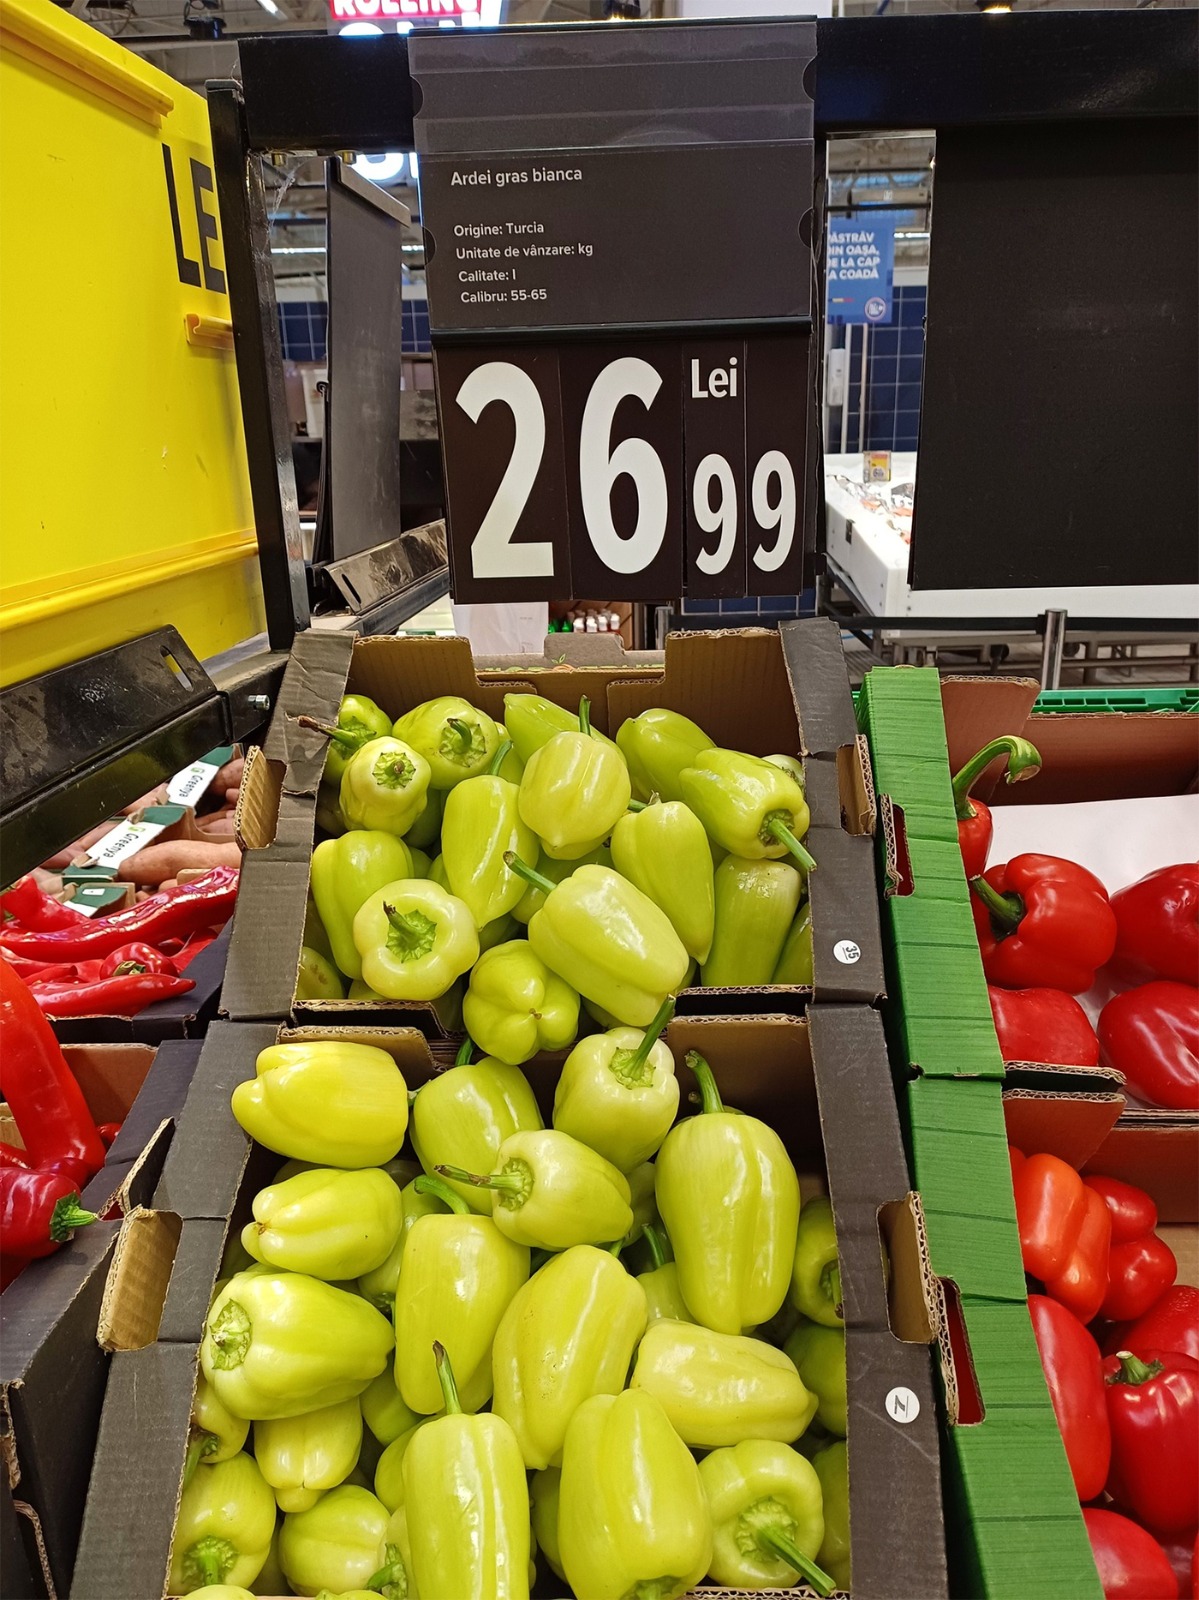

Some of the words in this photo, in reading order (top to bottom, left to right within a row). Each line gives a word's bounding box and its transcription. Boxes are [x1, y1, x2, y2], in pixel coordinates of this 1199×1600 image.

[451, 169, 492, 186] Ardei
[495, 170, 529, 187] gras
[532, 167, 583, 182] bianca
[453, 223, 503, 238] Origine:
[505, 221, 545, 235] Turcia
[828, 230, 875, 243] ĂSTRĂV
[456, 246, 501, 260] Unitate
[504, 246, 520, 257] de
[523, 244, 575, 257] vânzare:
[578, 242, 594, 257] kg
[458, 269, 510, 283] Calitate:
[460, 290, 508, 304] Calibru:
[510, 288, 549, 302] 55-65
[691, 357, 738, 399] Lei
[103, 832, 140, 858] Greenya
[845, 945, 860, 959] 35
